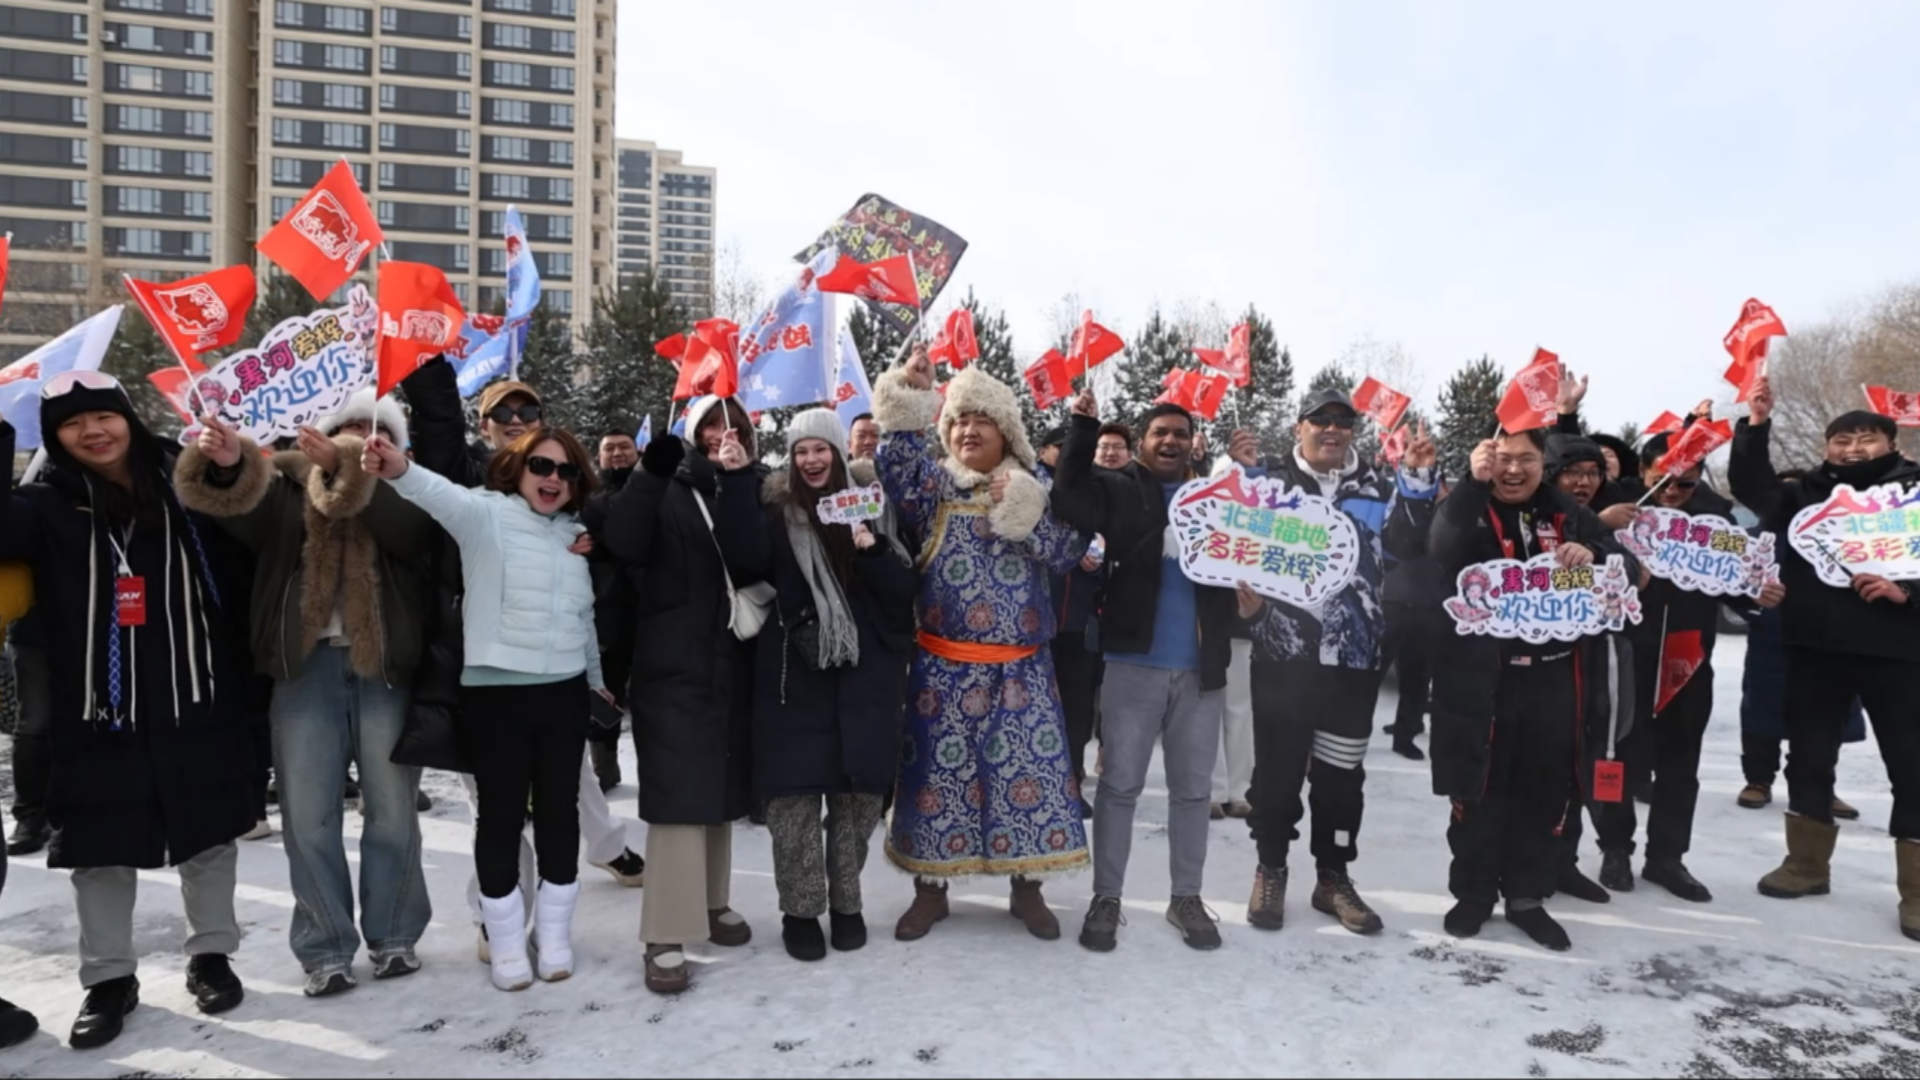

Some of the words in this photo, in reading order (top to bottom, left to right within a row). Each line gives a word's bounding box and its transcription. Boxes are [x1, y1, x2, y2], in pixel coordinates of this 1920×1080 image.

[234, 314, 344, 395] 黑河爱辉
[242, 346, 356, 428] 欢迎你
[1221, 504, 1328, 551] 北疆福地
[1667, 517, 1748, 555] 黑河爱辉
[1208, 532, 1315, 581] 多彩爱辉
[1658, 541, 1742, 582] 欢迎你
[1501, 566, 1595, 594] 黑河爱辉
[1499, 592, 1596, 623] 欢迎你
